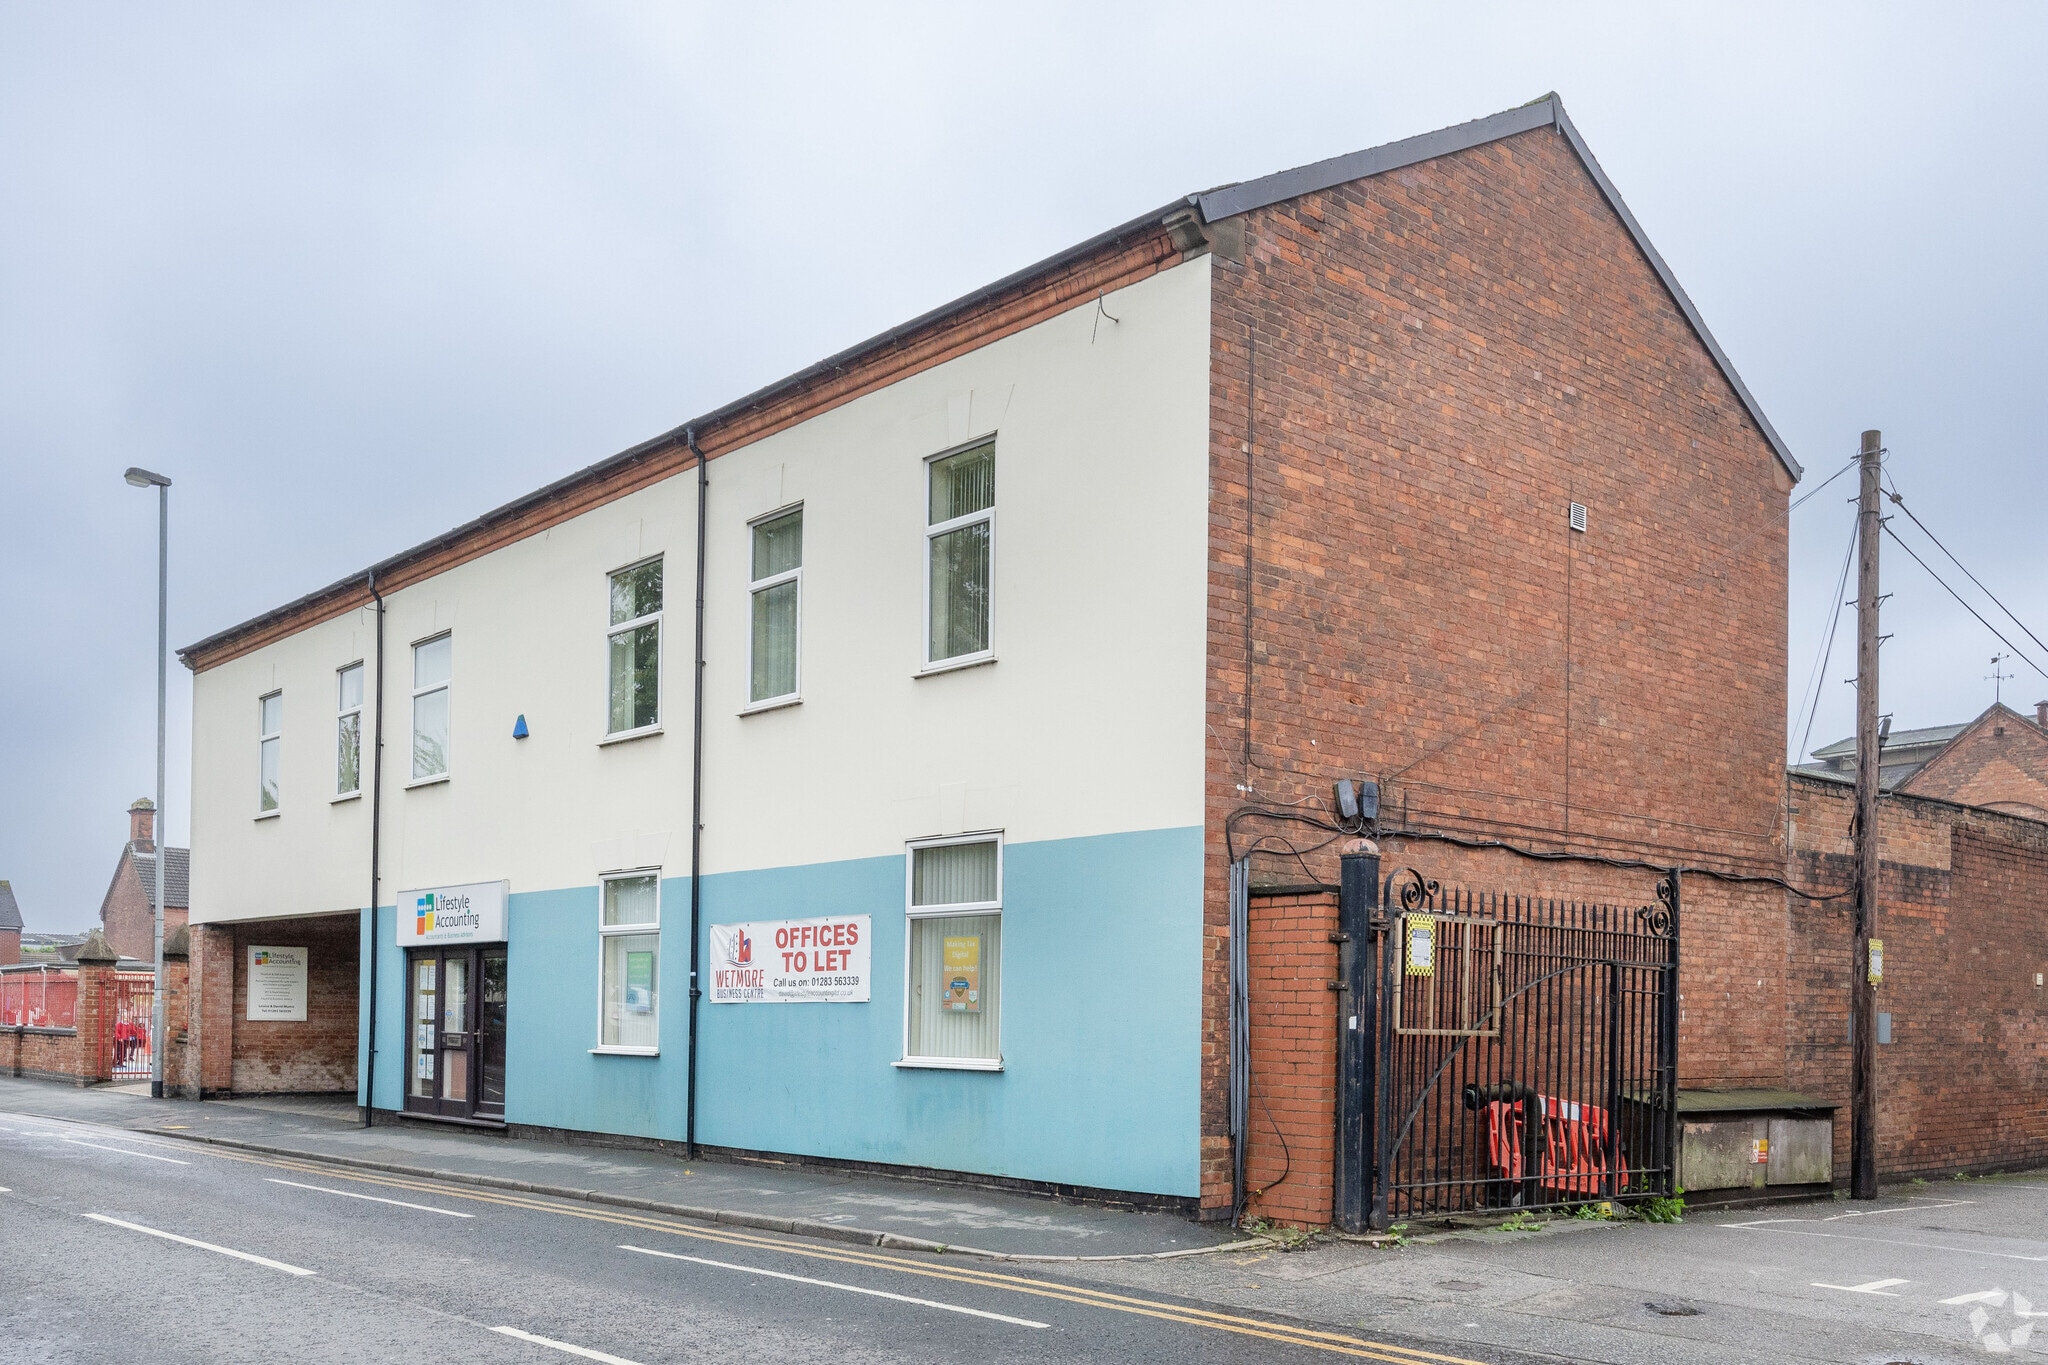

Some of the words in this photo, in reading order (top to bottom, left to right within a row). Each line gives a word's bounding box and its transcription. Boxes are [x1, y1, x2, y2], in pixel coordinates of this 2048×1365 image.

[435, 894, 470, 913] Lifestyle
[434, 909, 480, 929] Accounting
[775, 923, 859, 949] OFFICES
[781, 951, 807, 973] TO
[814, 949, 852, 972] LET
[715, 969, 764, 988] WETMORE
[773, 978, 787, 987] Call
[798, 979, 810, 987] on:
[811, 977, 833, 987] 01283
[834, 976, 860, 986] 563339
[716, 988, 742, 999] BUSINESS
[743, 988, 764, 999] CENTRE
